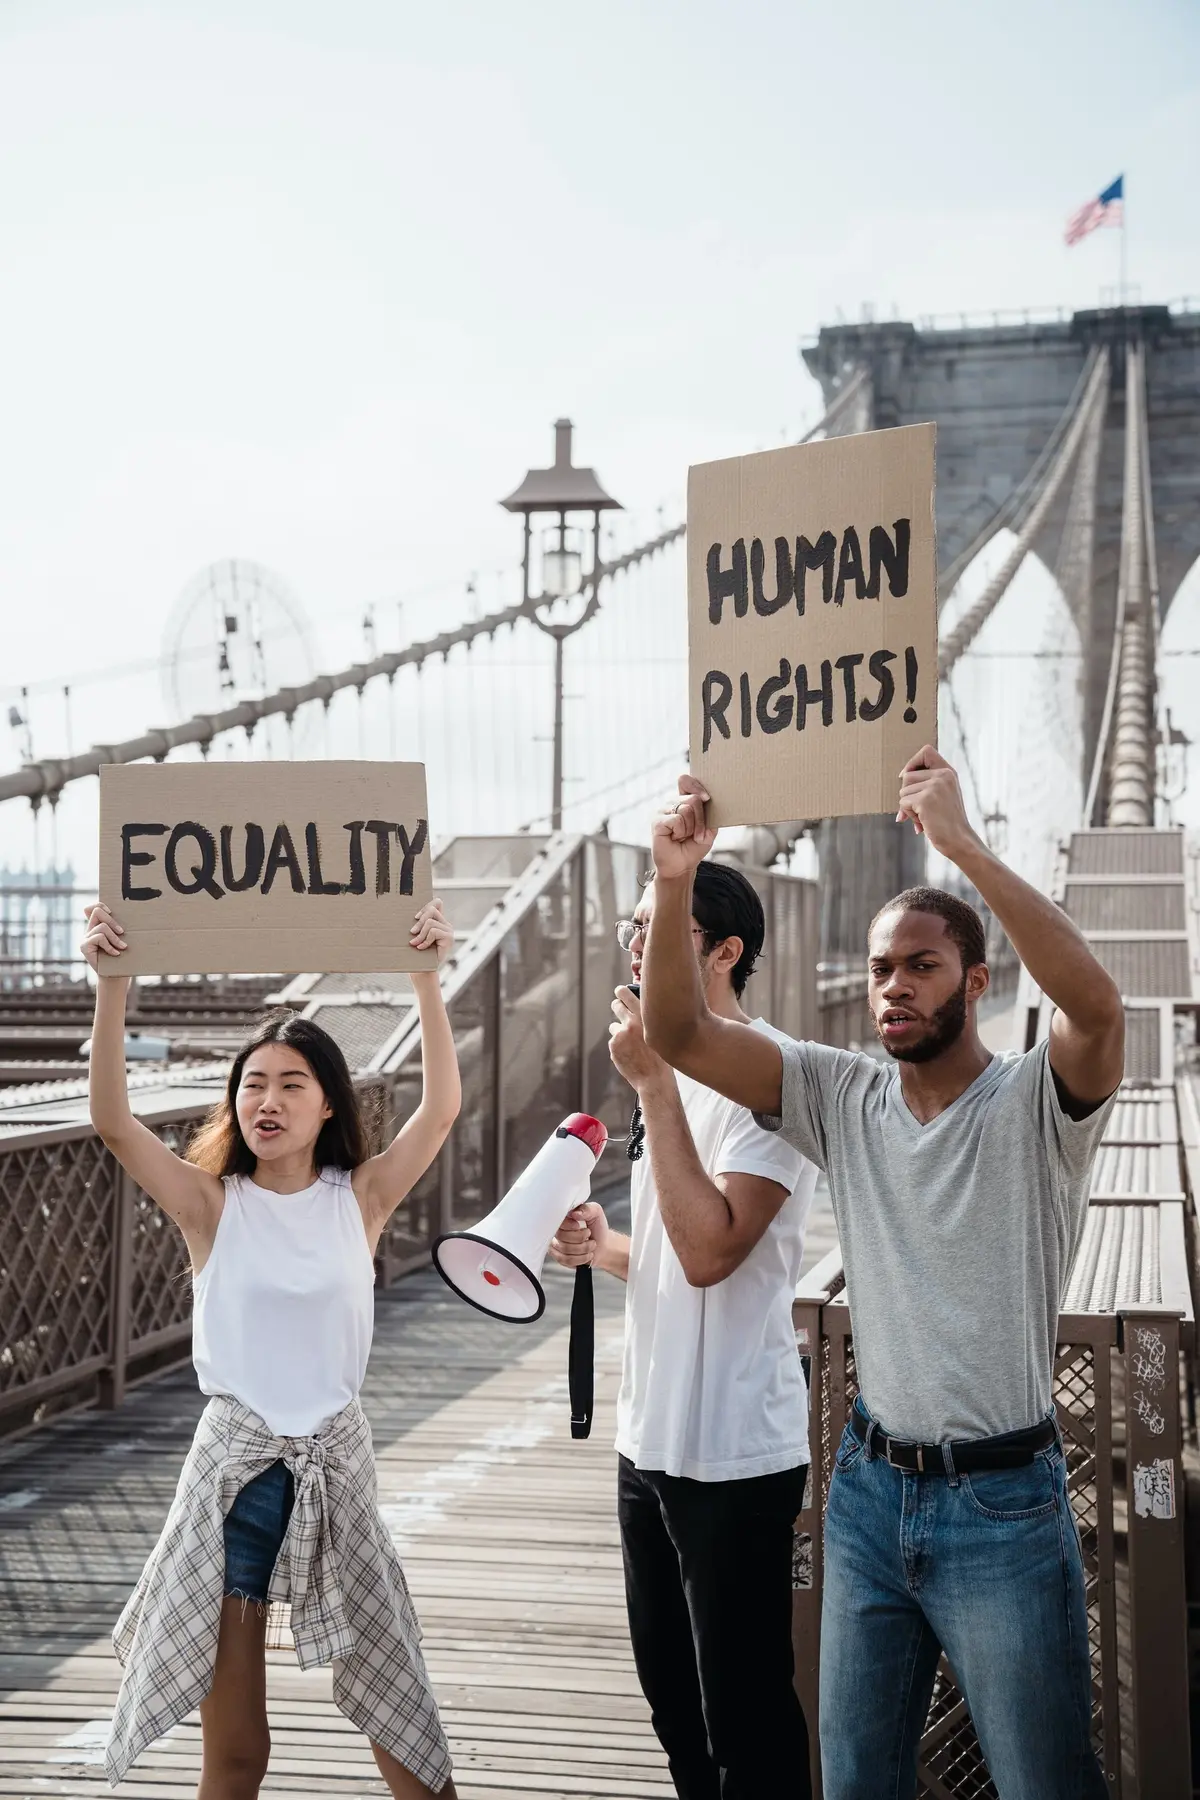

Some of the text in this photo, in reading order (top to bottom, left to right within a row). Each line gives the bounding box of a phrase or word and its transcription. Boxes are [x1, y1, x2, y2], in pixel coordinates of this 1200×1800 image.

[707, 519, 911, 625] HUMAN
[702, 646, 918, 753] RIGHTS!
[121, 818, 428, 900] EQUALITY
